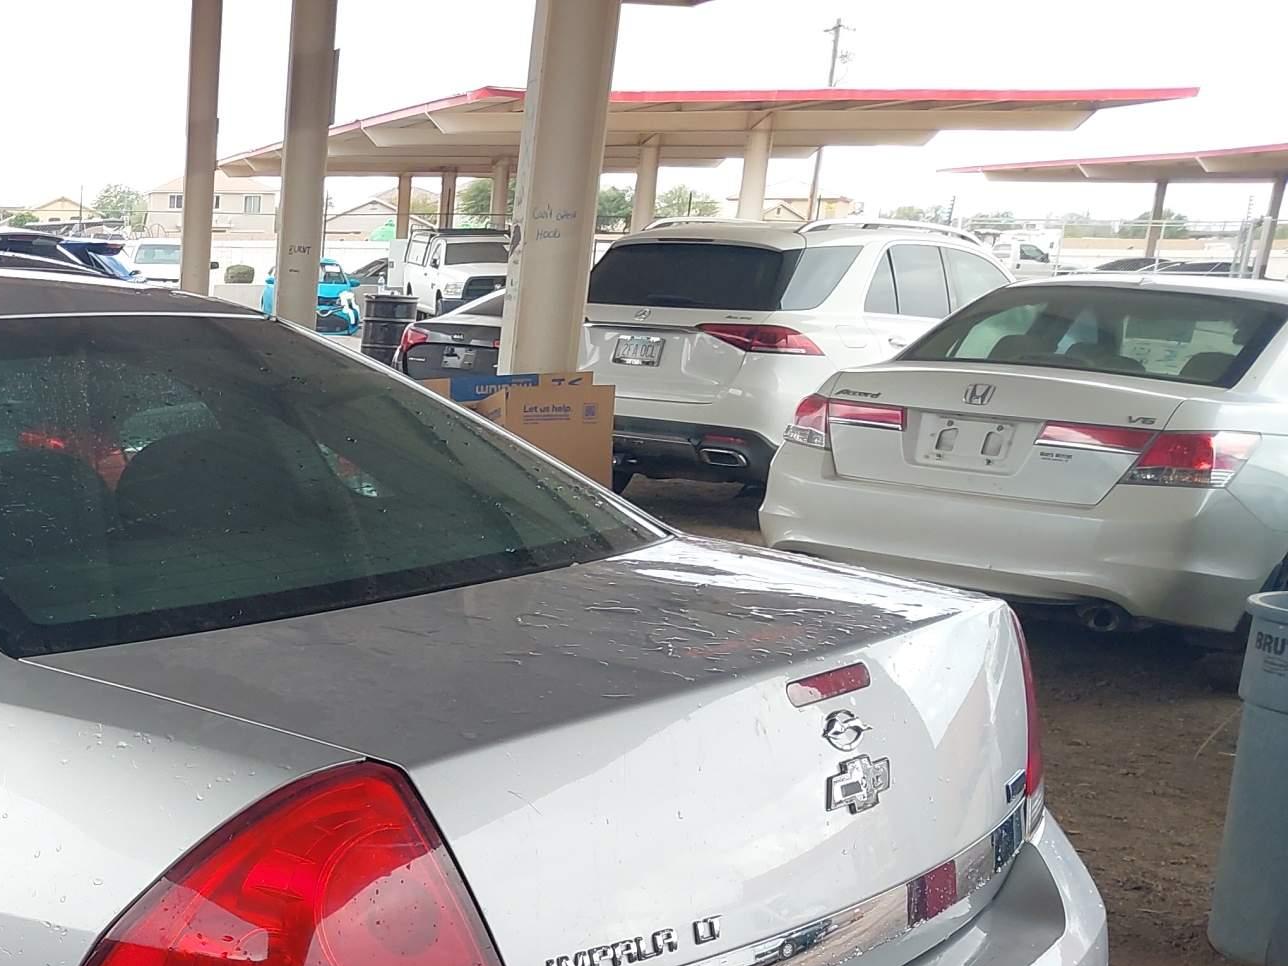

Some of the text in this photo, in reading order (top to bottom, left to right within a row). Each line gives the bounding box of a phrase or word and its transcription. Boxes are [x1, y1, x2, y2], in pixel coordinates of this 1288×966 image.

[834, 388, 882, 399] Accord
[523, 403, 538, 413] Let
[1127, 415, 1157, 425] V6
[1255, 631, 1288, 656] BRU
[692, 915, 723, 945] LT
